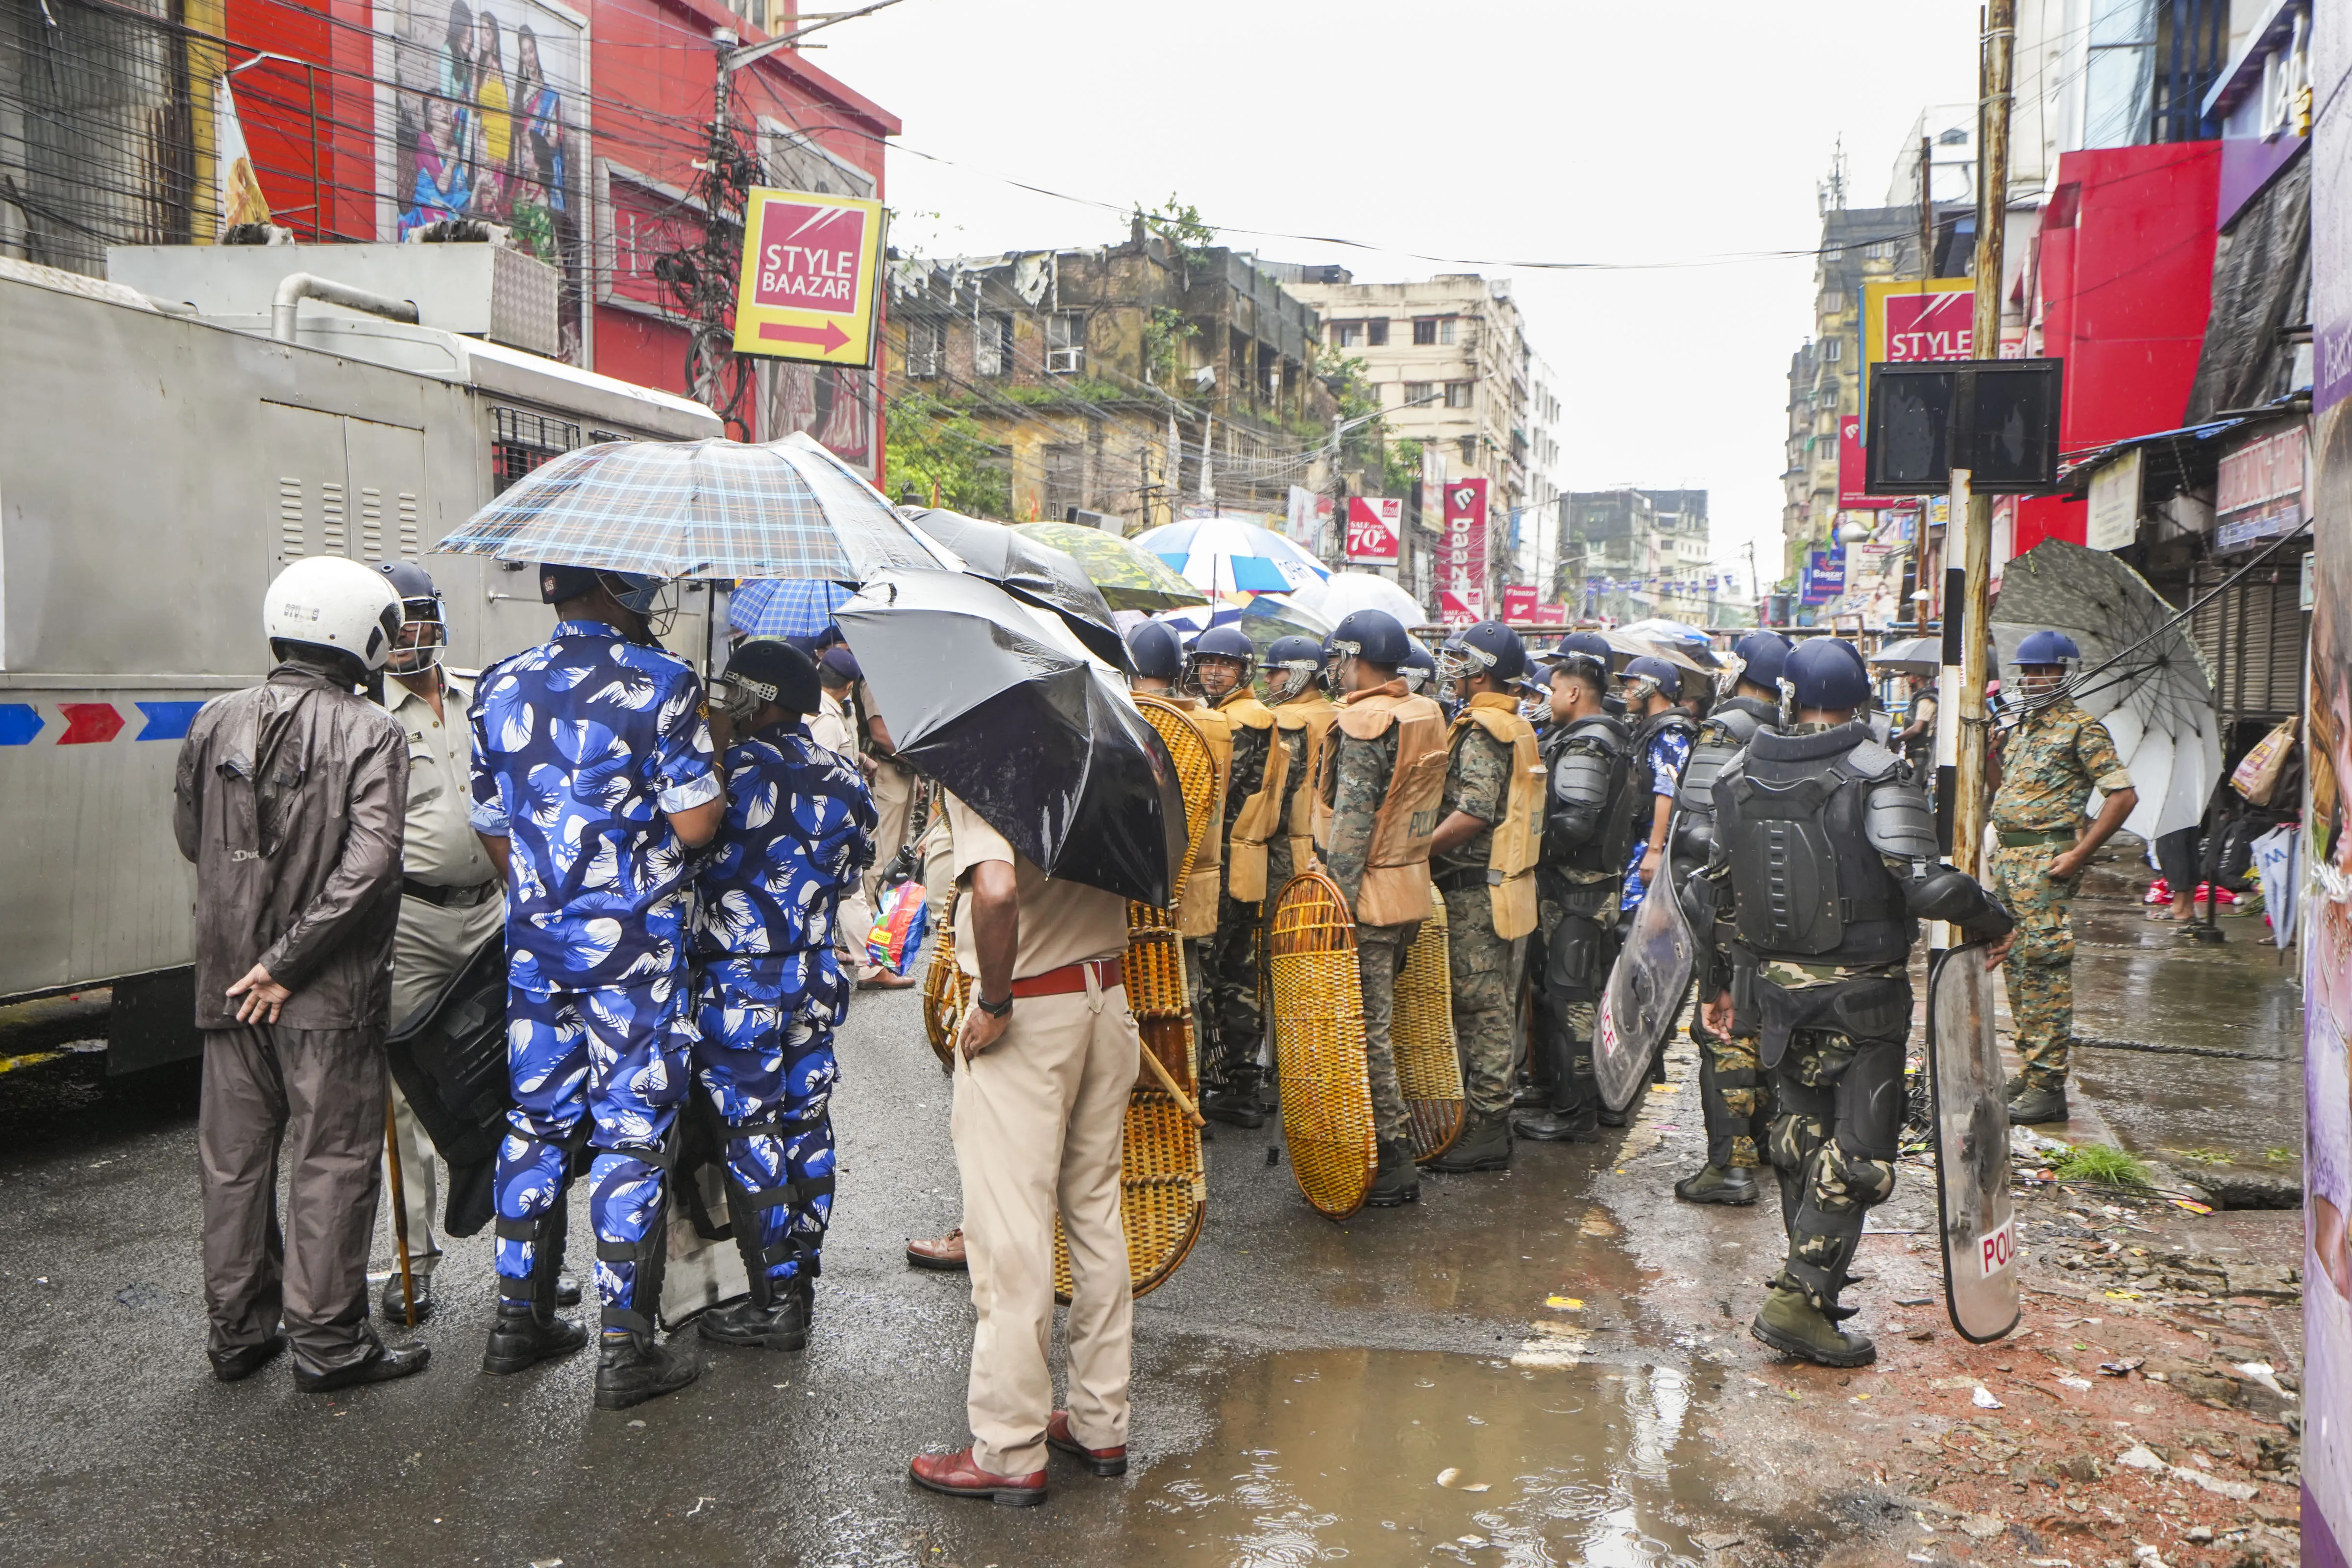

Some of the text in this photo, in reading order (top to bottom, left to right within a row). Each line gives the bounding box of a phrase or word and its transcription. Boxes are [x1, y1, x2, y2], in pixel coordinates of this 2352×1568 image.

[765, 244, 853, 278] STYLE
[762, 272, 851, 300] BAAZAR
[1891, 330, 1972, 357] STYLE
[1349, 529, 1387, 552] 70%
[545, 580, 554, 592] SS
[284, 603, 320, 622] STUS
